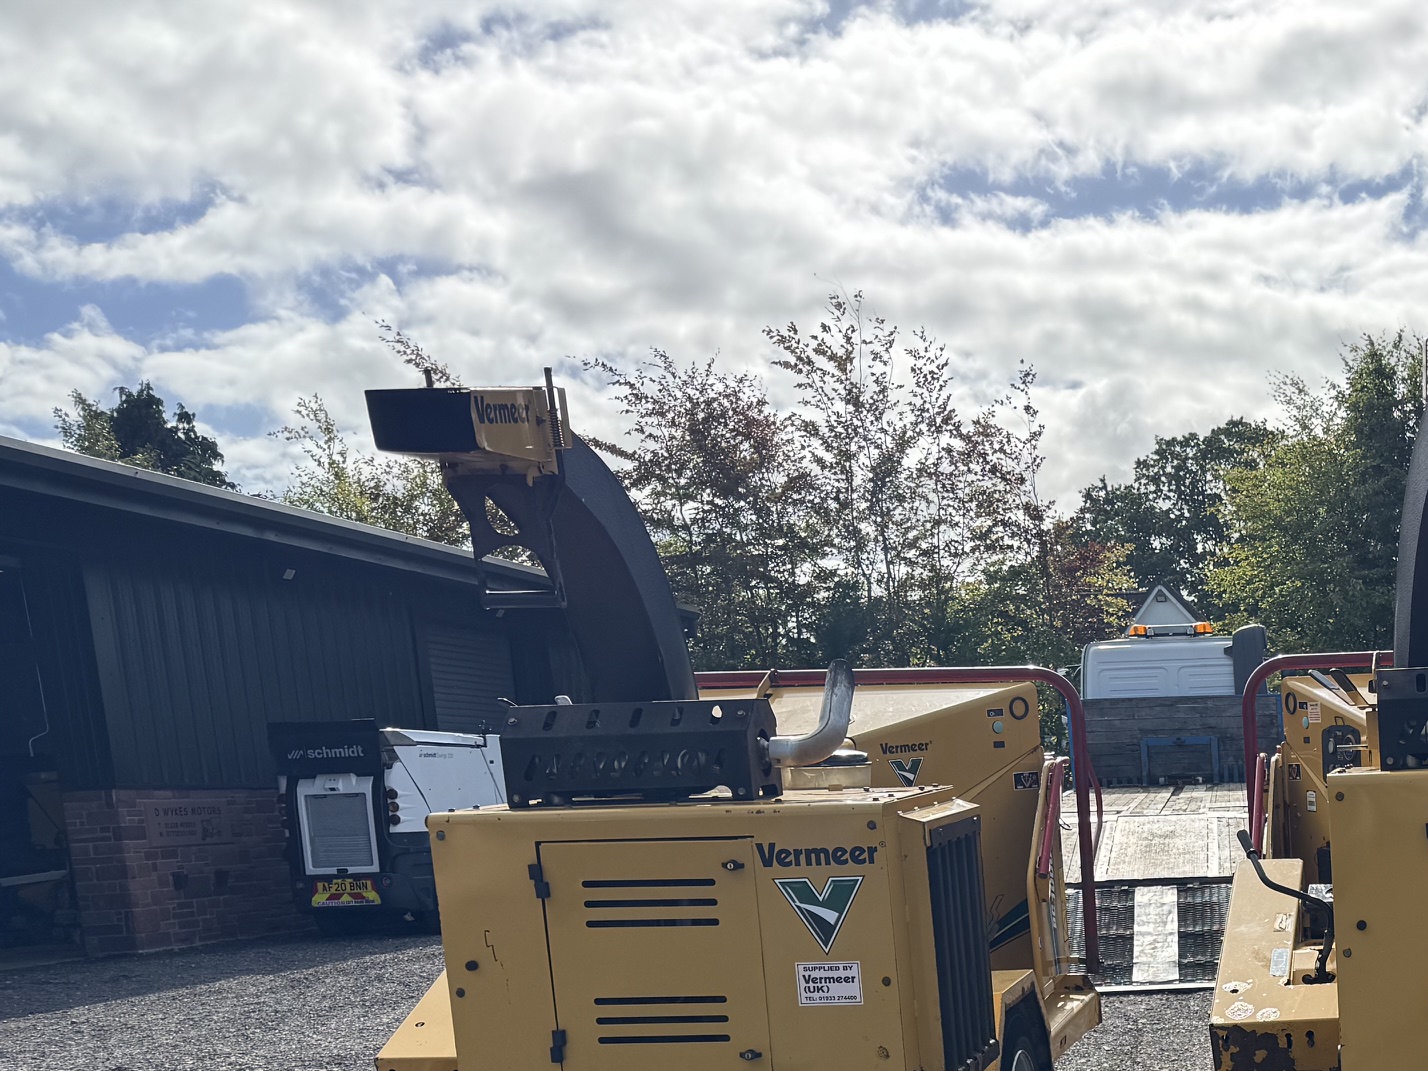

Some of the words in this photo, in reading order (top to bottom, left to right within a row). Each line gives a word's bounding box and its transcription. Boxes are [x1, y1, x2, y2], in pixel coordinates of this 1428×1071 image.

[473, 395, 530, 425] Vermeer
[307, 745, 364, 759] schmidt
[879, 742, 930, 755] Vermeer
[755, 842, 878, 868] Vermeer
[349, 881, 368, 891] BNN
[802, 974, 856, 985] Vermeer
[803, 985, 830, 994] (UK)
